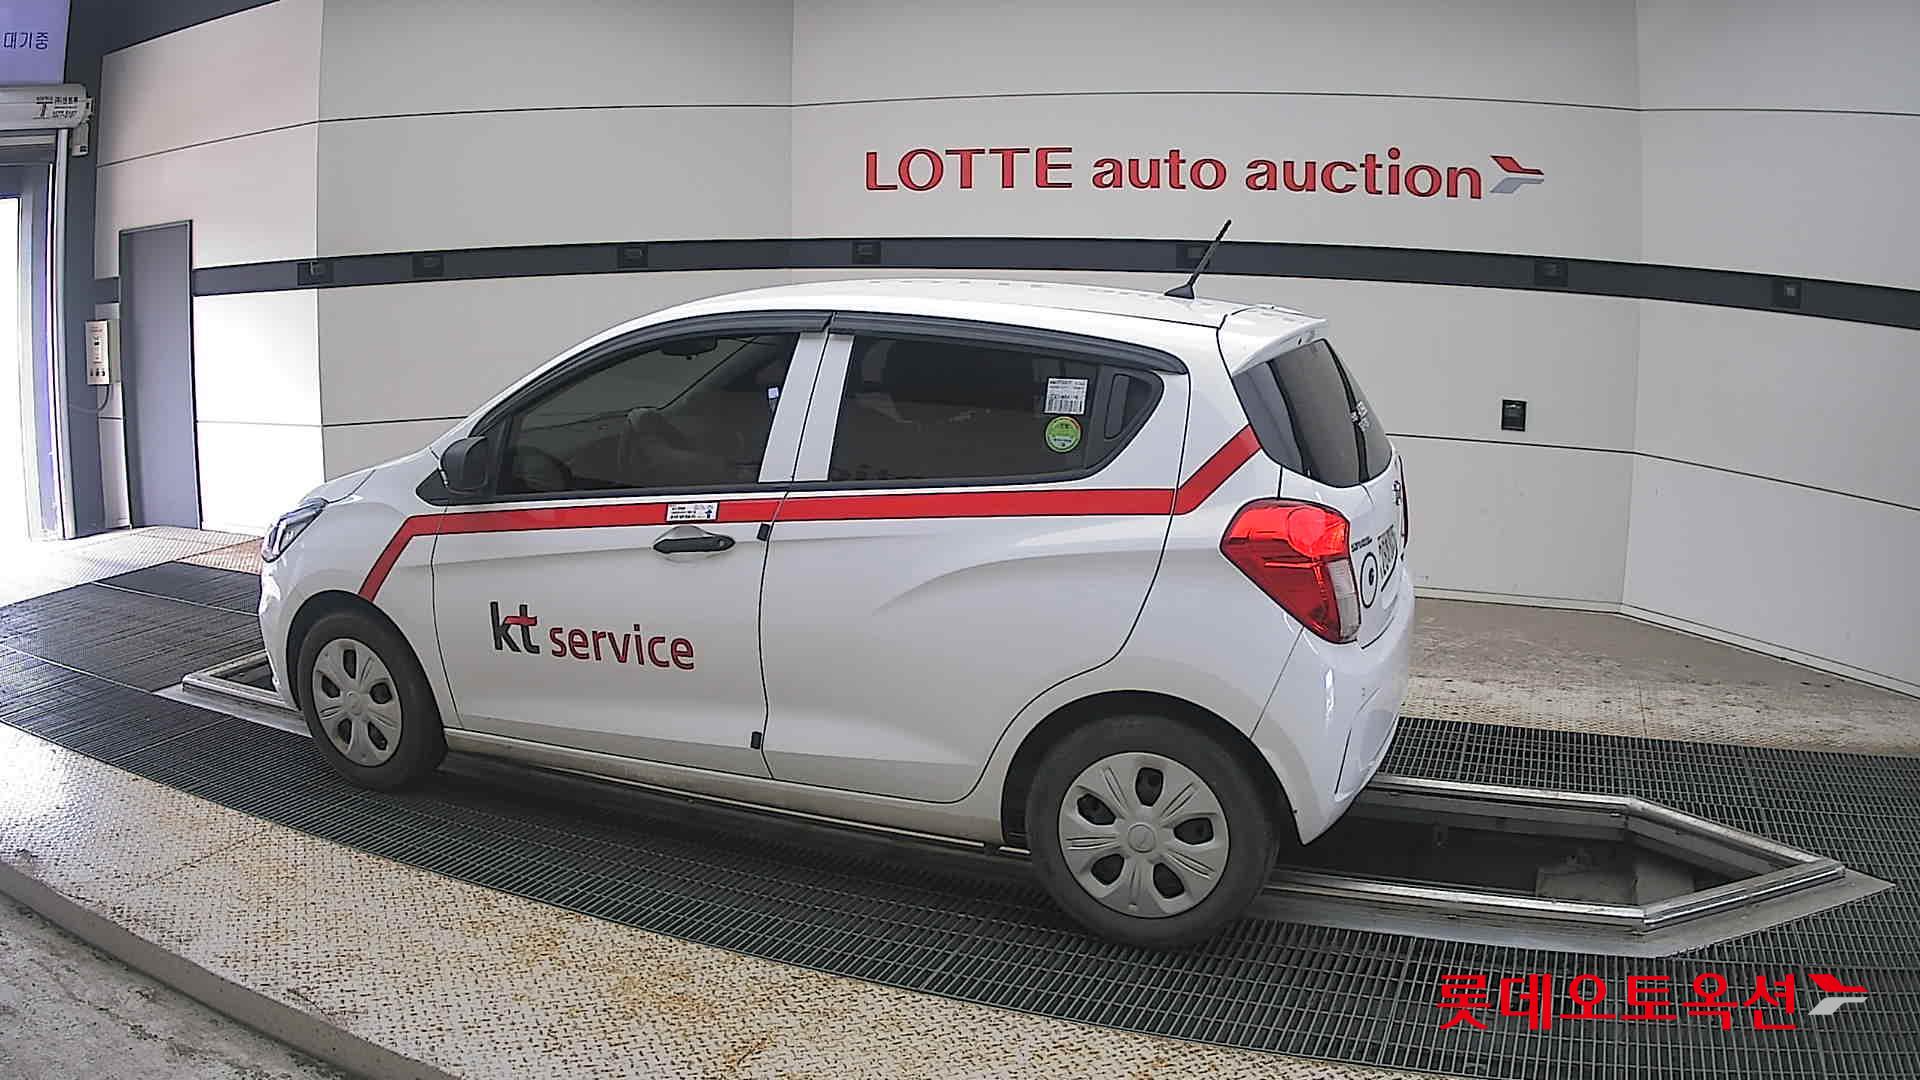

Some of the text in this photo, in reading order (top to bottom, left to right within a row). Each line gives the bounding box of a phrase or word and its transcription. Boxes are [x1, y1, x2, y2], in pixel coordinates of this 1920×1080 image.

[3, 31, 49, 50] 대기중
[865, 146, 1483, 200] LOTTE auto auction
[489, 600, 695, 671] kt service
